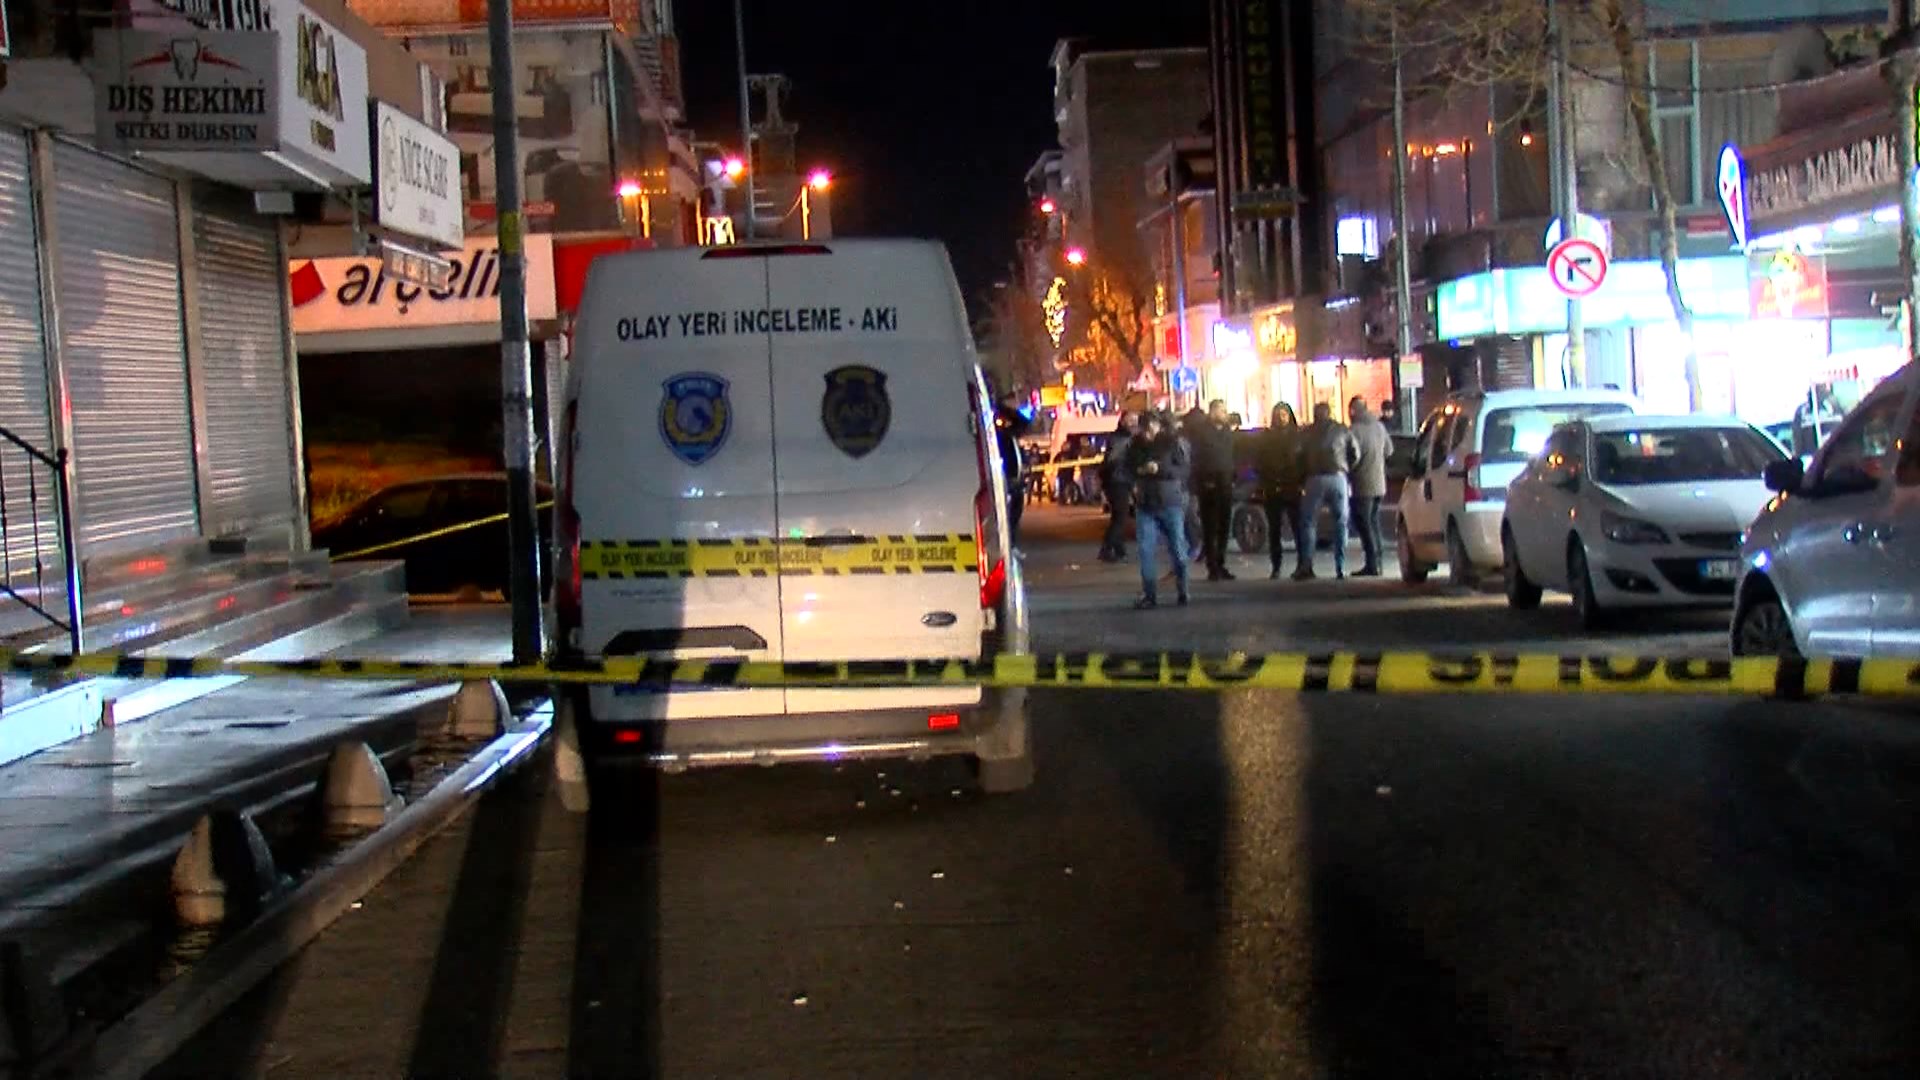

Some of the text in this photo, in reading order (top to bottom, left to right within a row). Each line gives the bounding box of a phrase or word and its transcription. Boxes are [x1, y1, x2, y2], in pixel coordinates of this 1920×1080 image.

[162, 78, 266, 115] HEKİMİ
[337, 249, 500, 314] arçeli
[617, 314, 670, 342] OLAY
